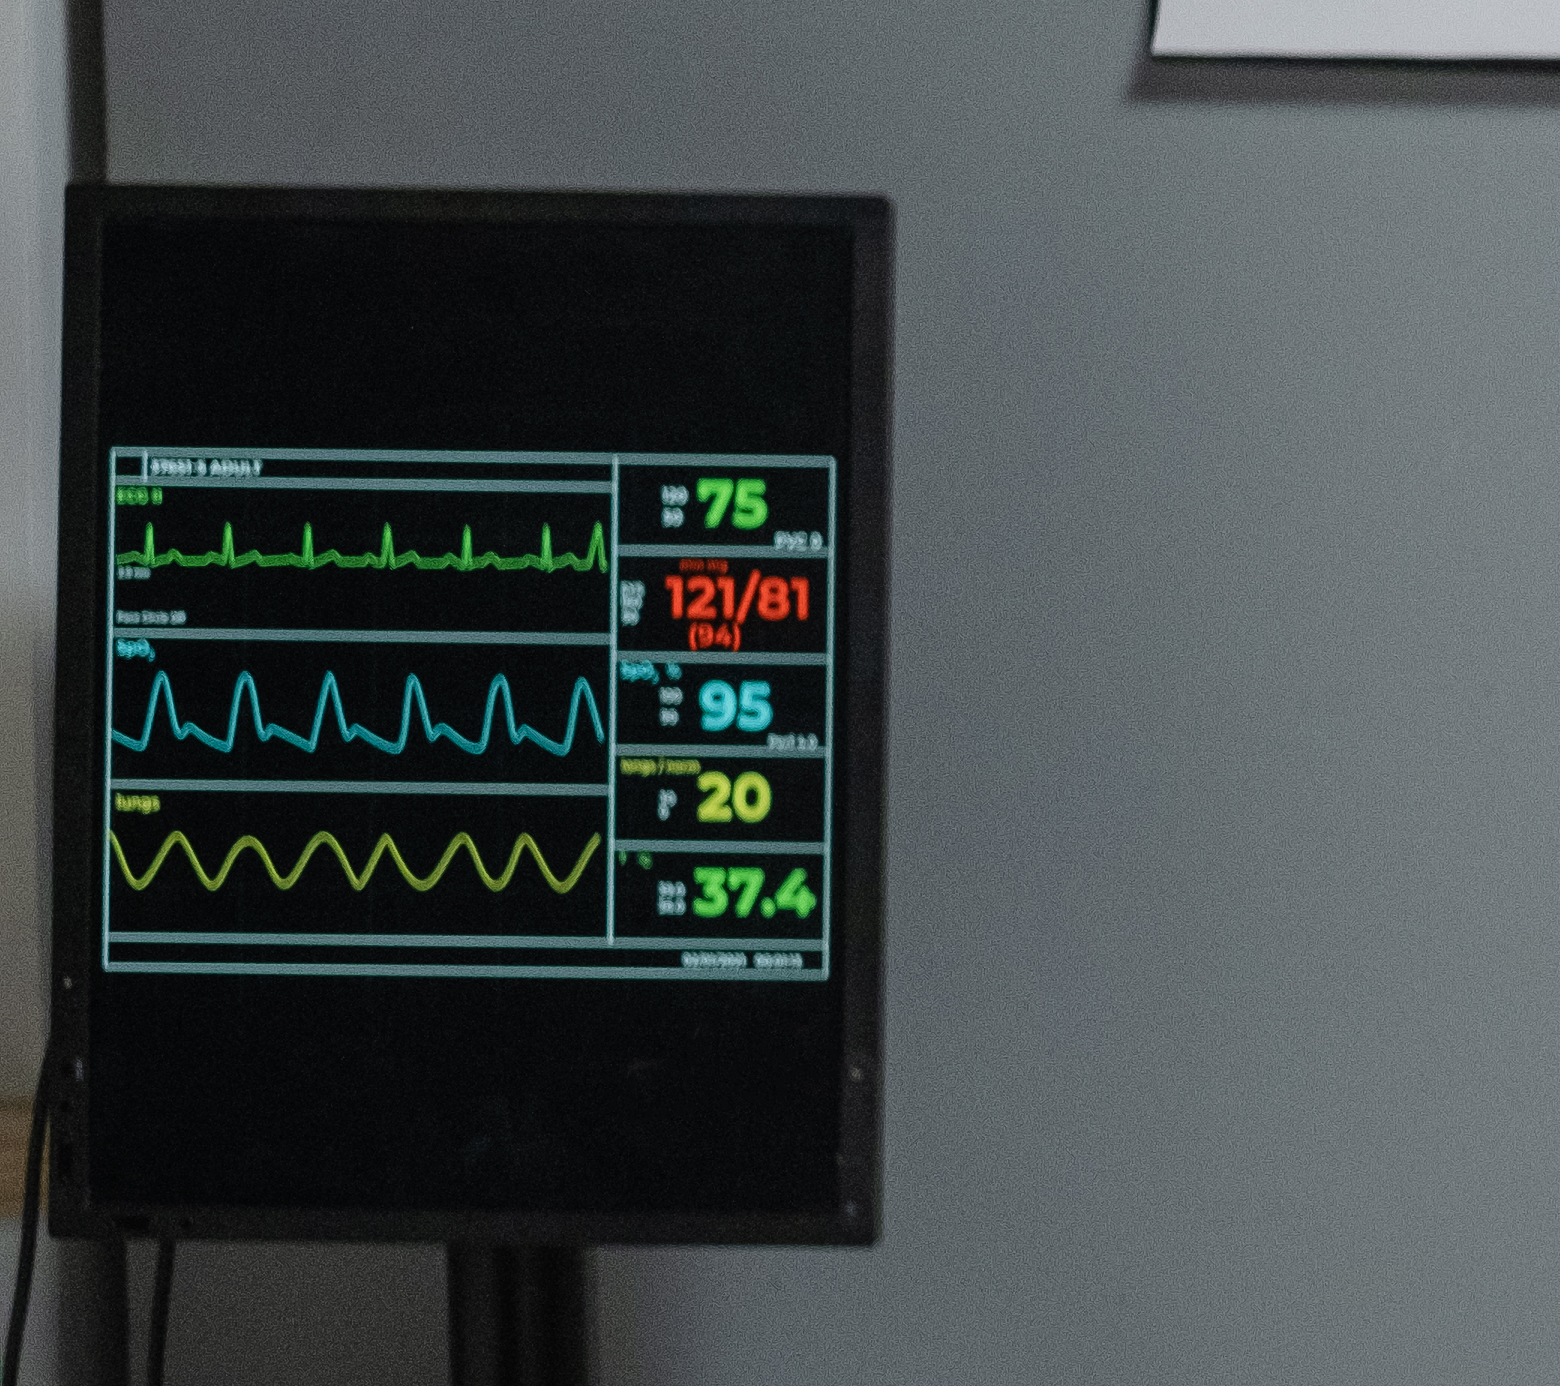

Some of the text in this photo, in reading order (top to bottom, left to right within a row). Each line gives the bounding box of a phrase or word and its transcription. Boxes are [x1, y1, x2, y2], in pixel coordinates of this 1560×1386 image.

[696, 478, 769, 530] 75
[664, 568, 810, 625] 121/81
[688, 622, 741, 652] (94)
[698, 679, 774, 732] 95
[115, 792, 161, 815] lungs
[696, 771, 773, 824] 20
[692, 866, 817, 919] 37.4
